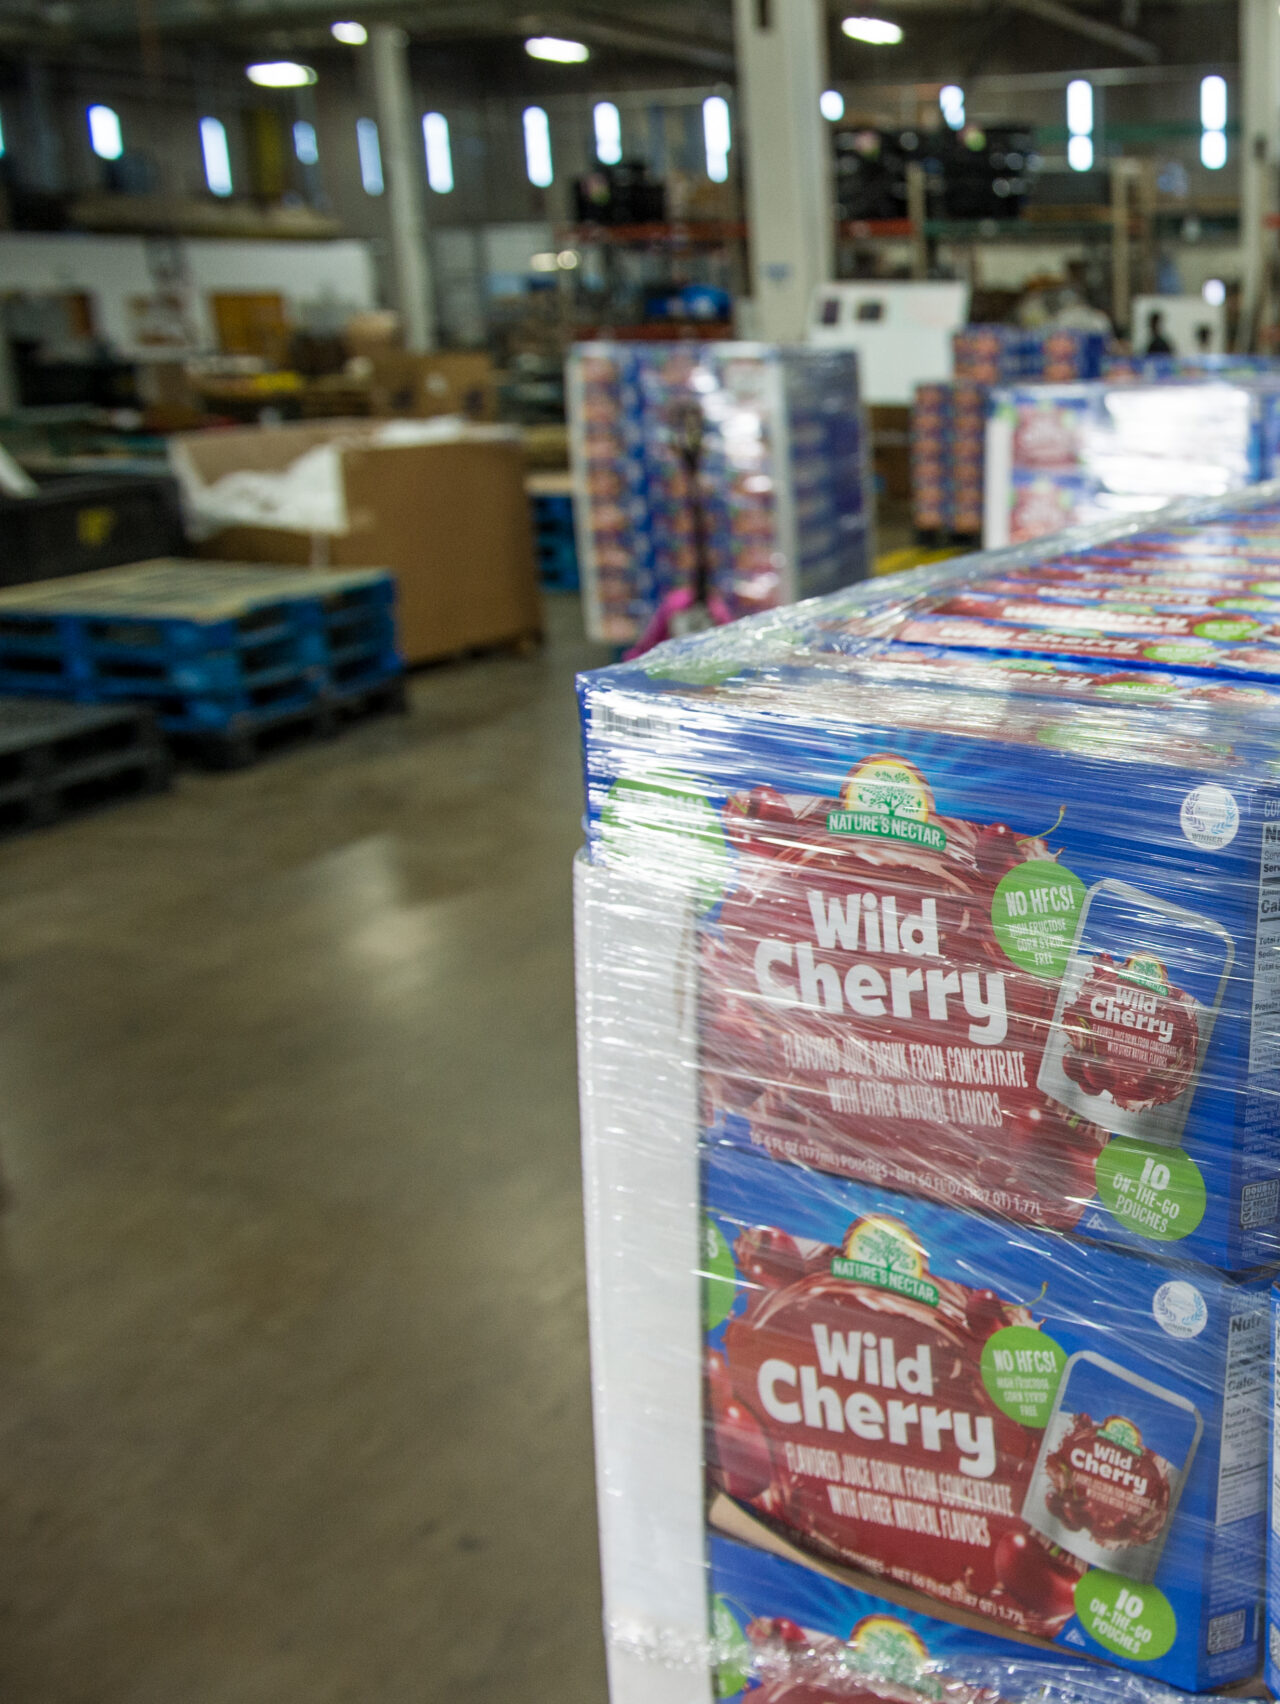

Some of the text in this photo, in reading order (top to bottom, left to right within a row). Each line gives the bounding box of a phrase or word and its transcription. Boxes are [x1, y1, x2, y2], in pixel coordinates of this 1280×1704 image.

[828, 813, 943, 847] NATURE'S NECTAR
[806, 889, 942, 957] Wild
[1004, 884, 1076, 918] NO HFCS!
[753, 940, 1009, 1046] Cherry
[1116, 985, 1158, 1015] Wild
[1089, 996, 1174, 1043] Cherry
[827, 1078, 1003, 1128] WITH OTHER NATURAL FLAVORS
[1112, 1173, 1181, 1220] ON-THE-GO
[1139, 1157, 1171, 1193] 10
[1115, 1192, 1169, 1233] POUCHES
[831, 1261, 937, 1303] NATURE'S NECTAR
[810, 1323, 936, 1398] Wild
[992, 1348, 1058, 1375] NO HFCS!
[756, 1357, 999, 1480] Cherry
[1020, 1403, 1038, 1418] FREE
[1070, 1447, 1148, 1496] Cherry
[1093, 1441, 1133, 1471] Wild
[784, 1441, 1015, 1518] FLAVORED JUICE DRINK FROM CONCENTRATE
[827, 1483, 991, 1549] WITH OTHER NATURAL FLAVORS
[1088, 1597, 1153, 1645] ON-THE-GO
[1113, 1587, 1144, 1620] 10
[1090, 1614, 1142, 1656] POUCHES
